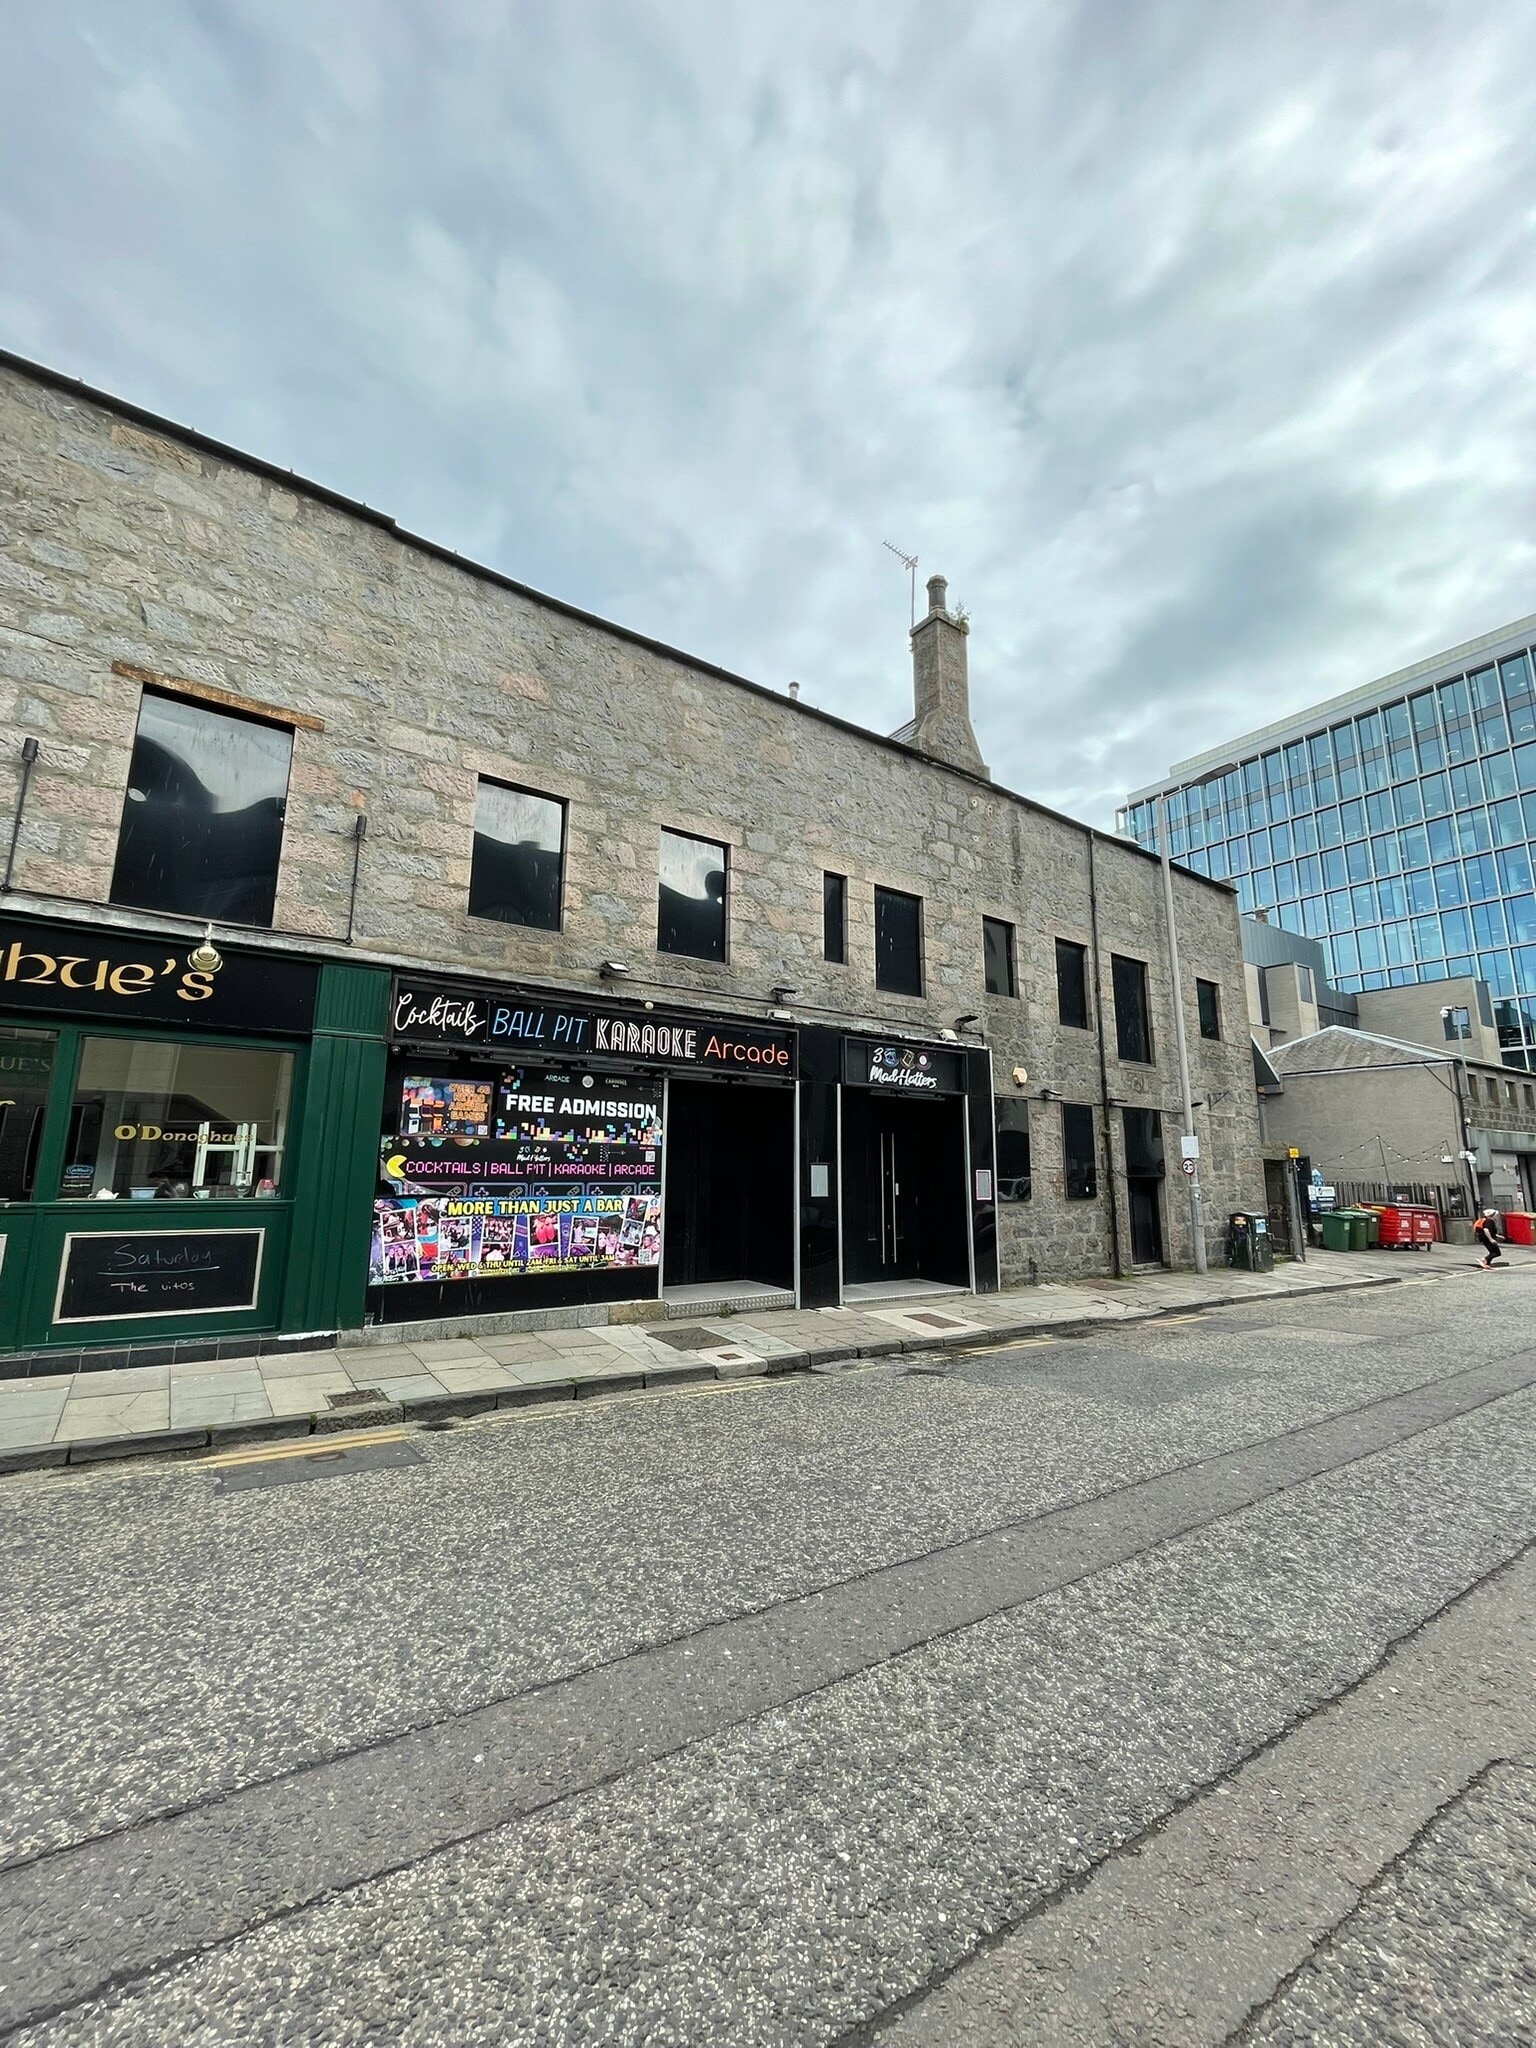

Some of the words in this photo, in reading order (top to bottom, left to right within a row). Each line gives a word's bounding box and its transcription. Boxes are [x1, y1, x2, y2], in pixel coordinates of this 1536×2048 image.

[0, 942, 215, 1001] hue's
[394, 993, 487, 1036] Cocktails
[492, 1008, 545, 1038] BALL
[552, 1015, 589, 1044] PIT
[595, 1018, 697, 1059] KARAOKE
[704, 1035, 789, 1066] Arcade
[506, 1094, 555, 1113] FREE
[559, 1098, 657, 1119] ADMISSION
[405, 1161, 481, 1174] COCKTAILS
[490, 1163, 524, 1175] BALL
[554, 1164, 607, 1175] KARAOKE
[614, 1165, 656, 1175] ARCADE
[448, 1201, 494, 1216] MORE
[499, 1201, 540, 1214] THAN
[544, 1199, 580, 1214] JUST
[583, 1200, 593, 1213] A
[596, 1199, 623, 1212] BAR
[114, 1244, 212, 1267] Saturday
[111, 1281, 149, 1293] The
